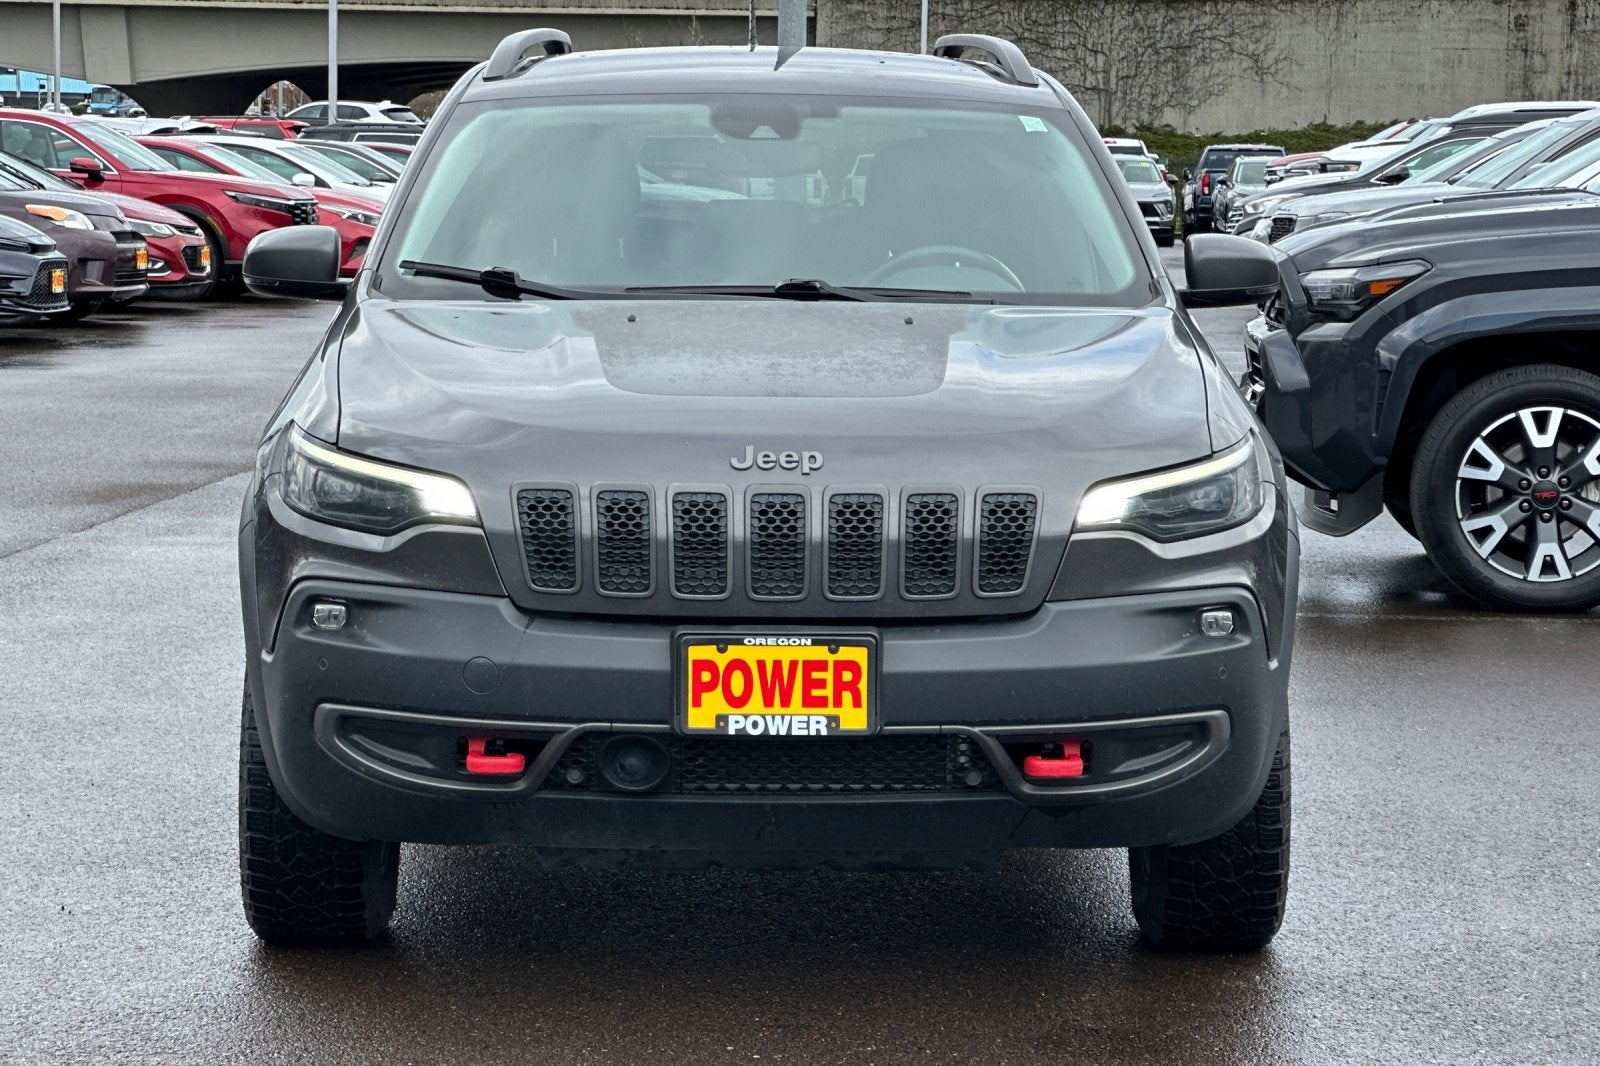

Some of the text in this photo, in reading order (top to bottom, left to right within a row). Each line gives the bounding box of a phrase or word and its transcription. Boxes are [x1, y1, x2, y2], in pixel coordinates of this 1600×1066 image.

[730, 445, 824, 475] Jeep
[743, 637, 812, 646] OREGON
[691, 658, 863, 709] POWER
[728, 715, 828, 736] POWER
